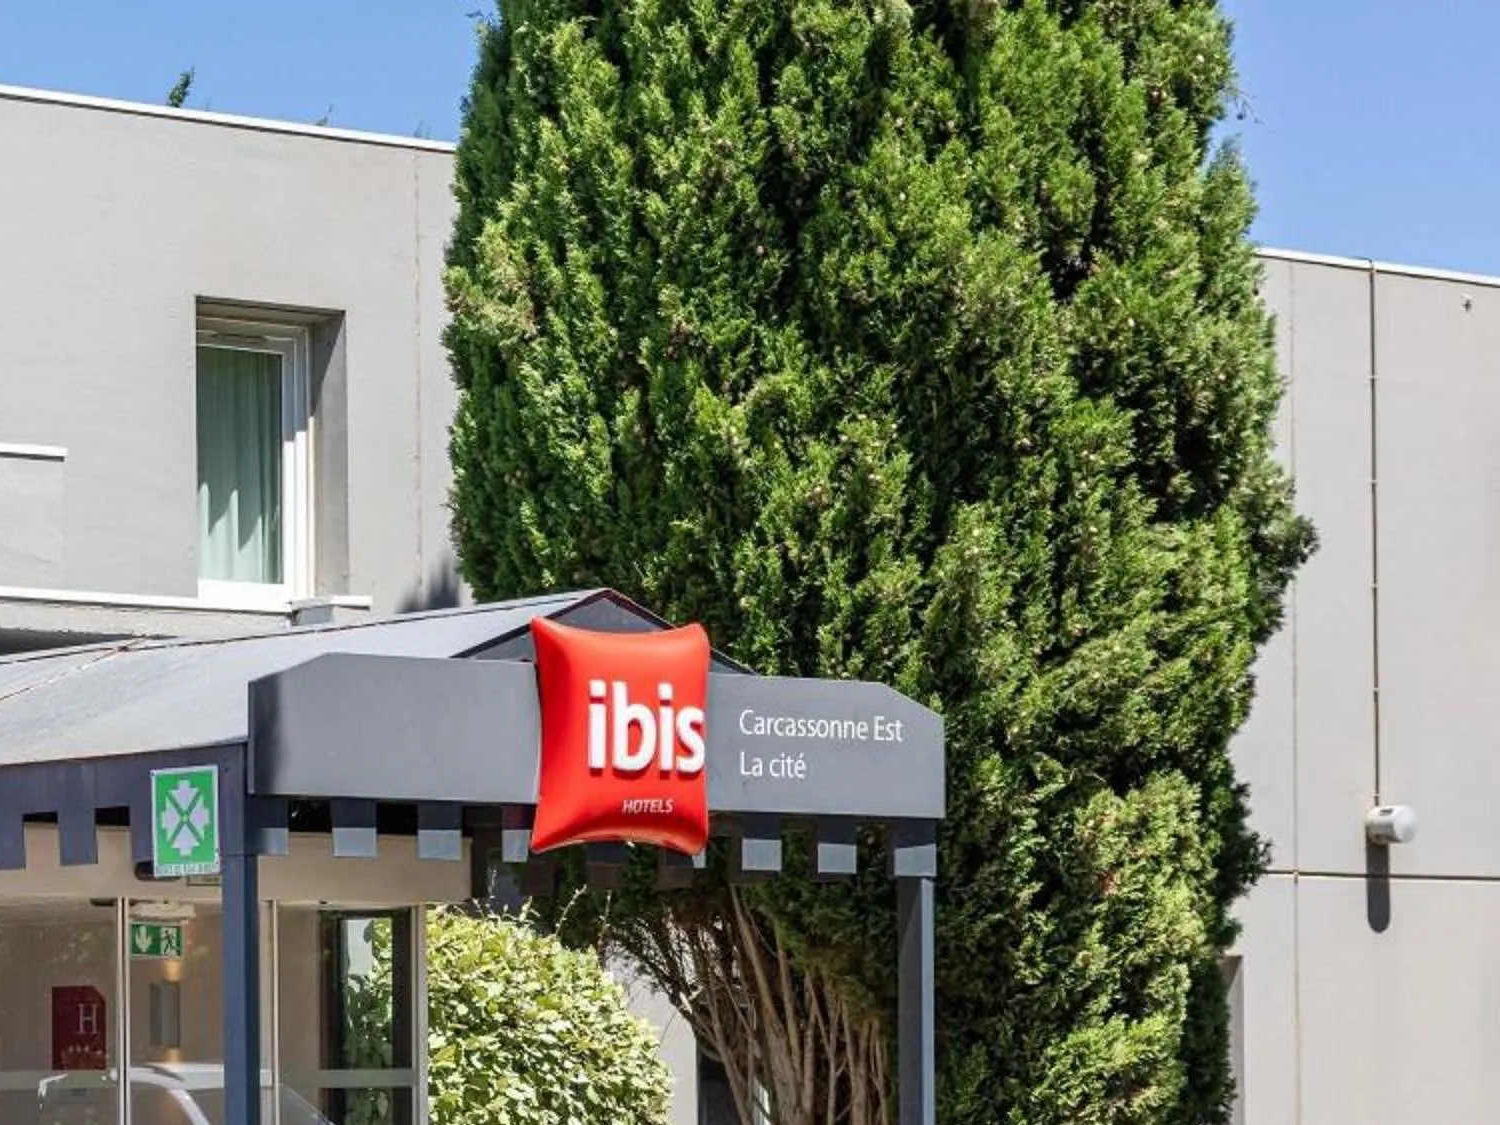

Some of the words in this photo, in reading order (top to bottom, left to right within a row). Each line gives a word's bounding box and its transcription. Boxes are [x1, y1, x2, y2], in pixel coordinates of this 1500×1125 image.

[588, 679, 705, 773] ibis
[739, 709, 868, 741] Carcassonne
[873, 715, 904, 742] Est
[740, 751, 763, 776] La
[769, 752, 807, 778] cité
[622, 799, 674, 814] HOTELS
[78, 1003, 97, 1034] H
